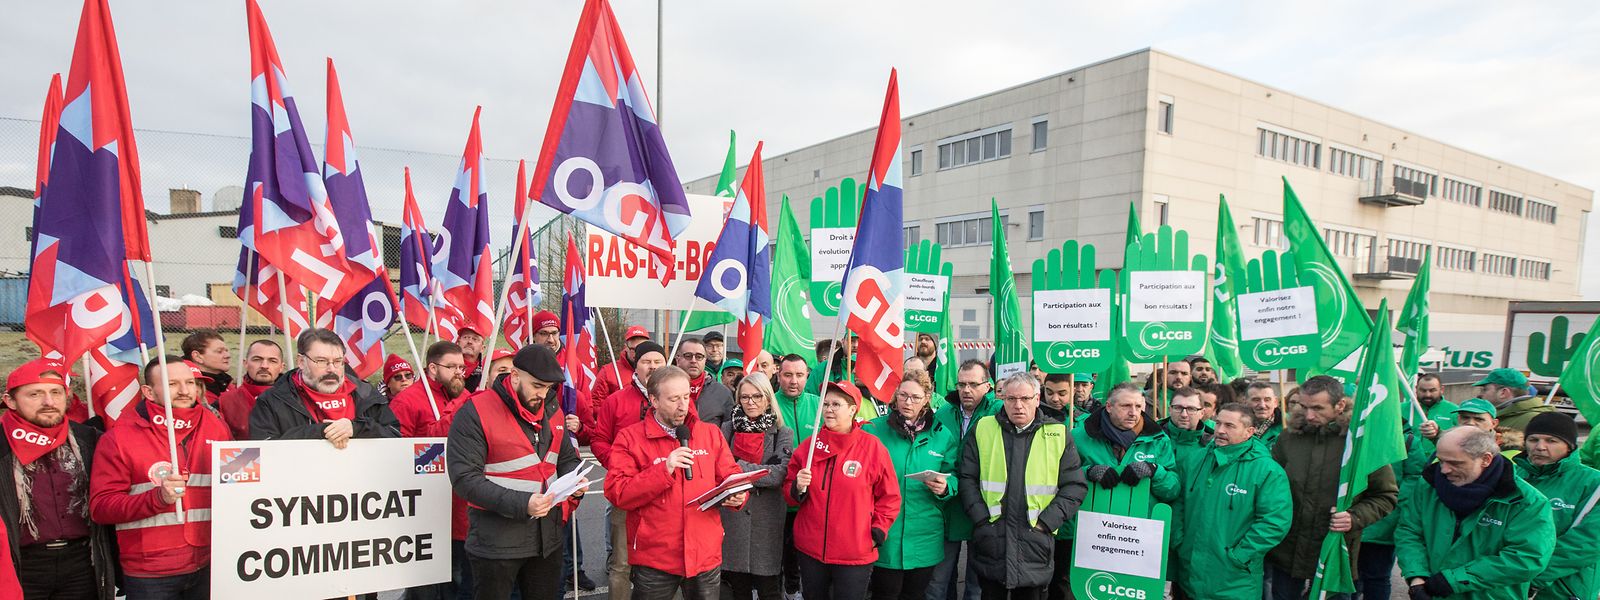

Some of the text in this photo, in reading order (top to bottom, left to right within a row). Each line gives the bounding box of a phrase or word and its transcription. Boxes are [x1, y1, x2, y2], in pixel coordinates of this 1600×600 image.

[588, 233, 716, 281] RAS-L-B
[1260, 295, 1292, 303] Valorisez
[1276, 304, 1296, 312] notre
[1254, 314, 1296, 324] engagement
[1159, 331, 1192, 340] LCGB
[1066, 348, 1100, 358] LCGB
[1272, 345, 1308, 356] LCGB
[250, 488, 422, 530] SYNDICAT
[1102, 520, 1138, 532] Valorisez
[1118, 536, 1140, 544] notre
[1092, 544, 1139, 556] engagement
[236, 533, 432, 582] COMMERCE
[1108, 584, 1146, 600] LCGB
